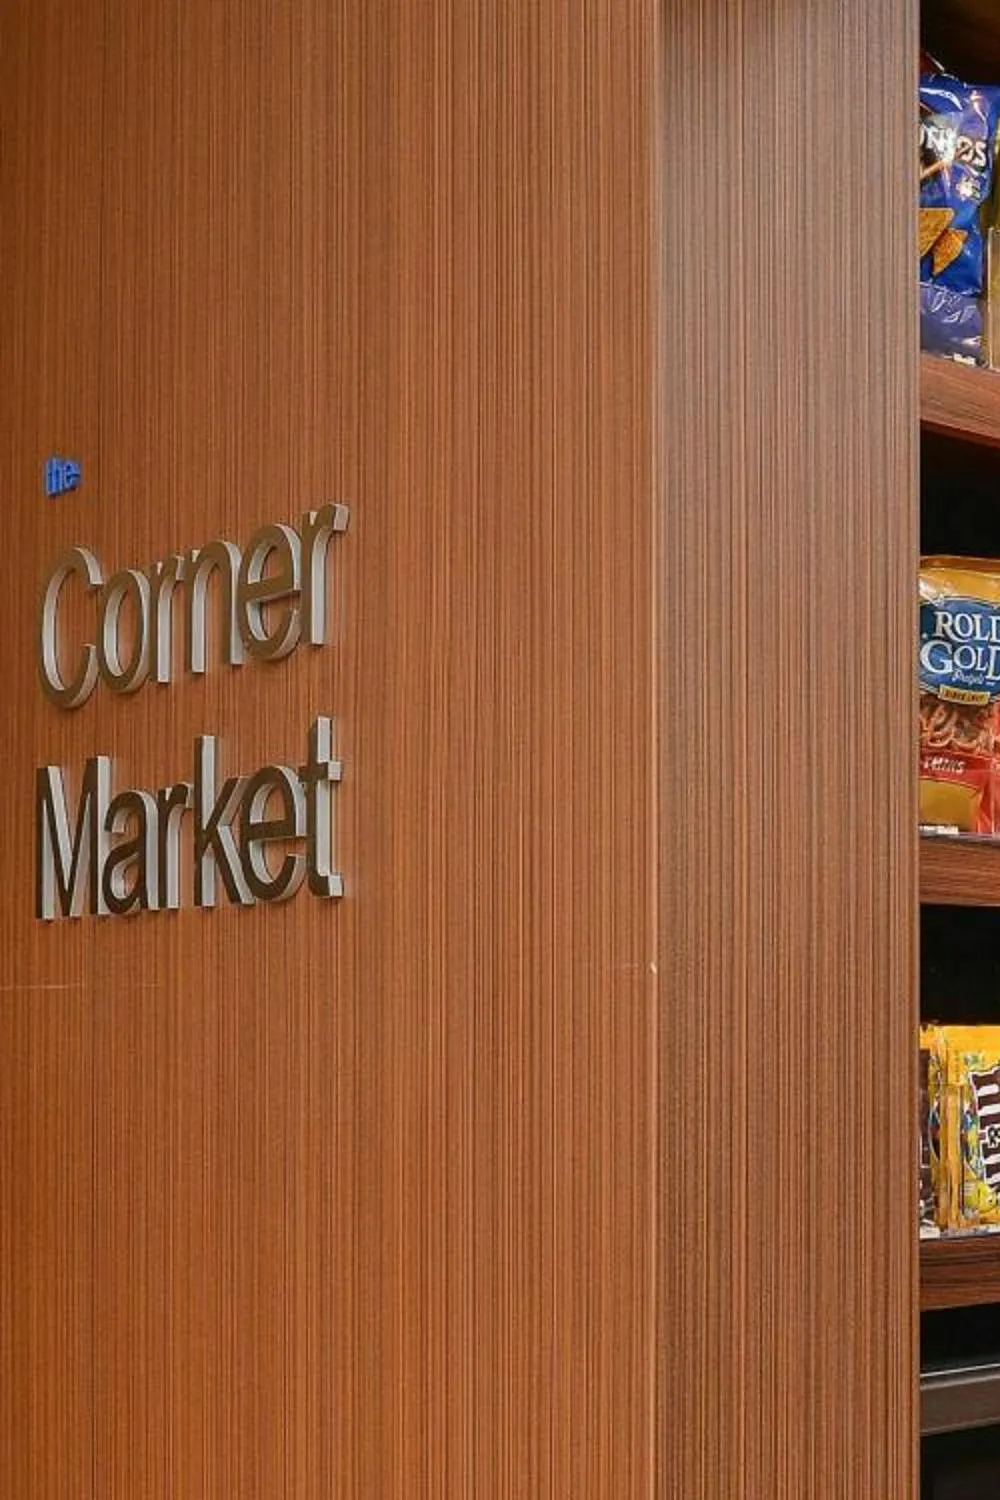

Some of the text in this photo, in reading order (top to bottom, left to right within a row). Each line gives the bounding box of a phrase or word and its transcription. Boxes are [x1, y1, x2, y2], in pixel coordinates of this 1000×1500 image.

[46, 457, 81, 496] the
[40, 502, 349, 710] Corner
[36, 716, 345, 921] Market
